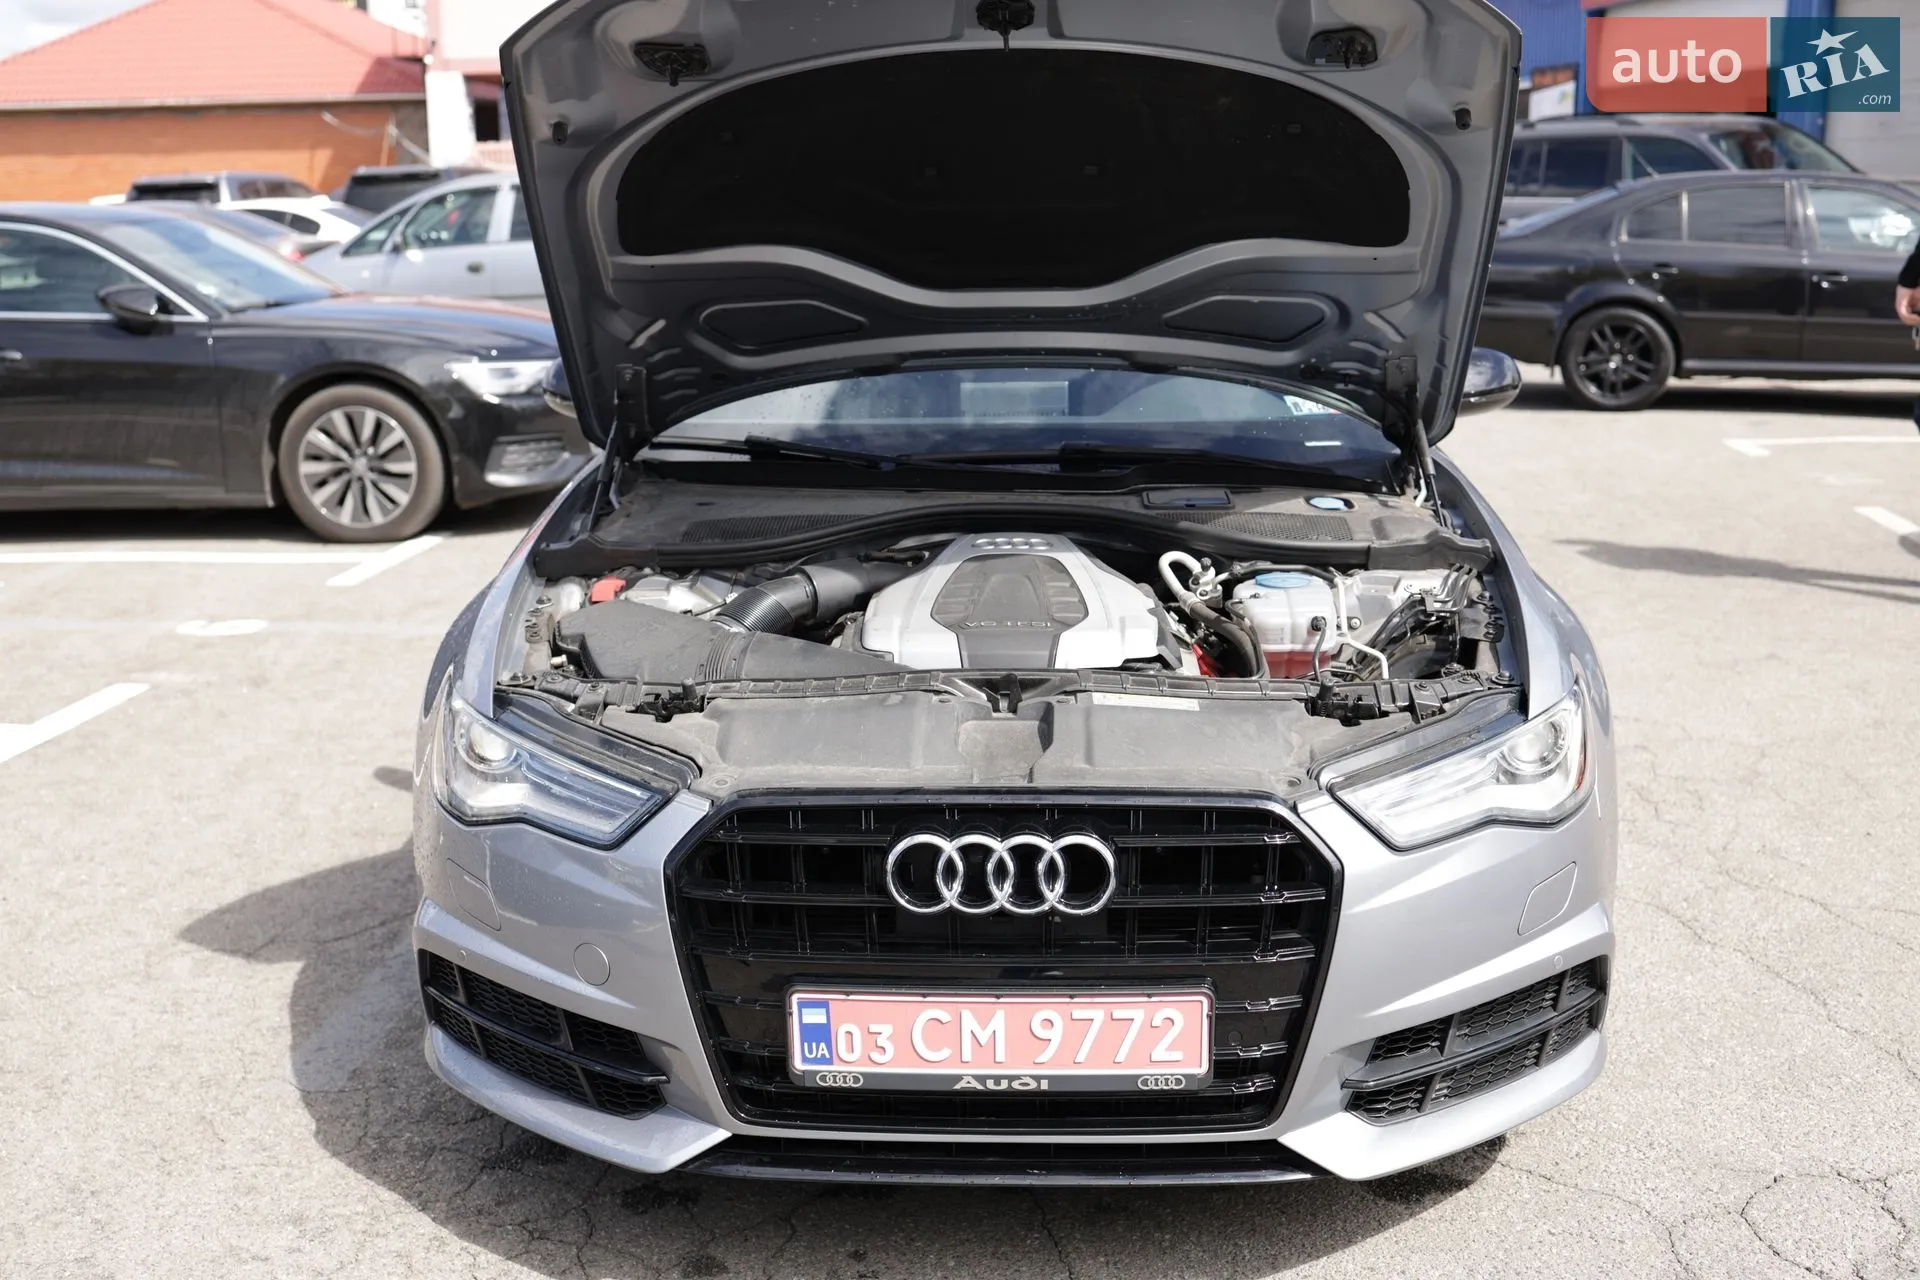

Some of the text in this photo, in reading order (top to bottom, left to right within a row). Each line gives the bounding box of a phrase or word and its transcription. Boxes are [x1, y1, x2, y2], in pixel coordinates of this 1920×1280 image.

[836, 1008, 1184, 1065] 03 CM 9772
[804, 1041, 830, 1059] UA
[953, 1075, 1049, 1091] Audi
